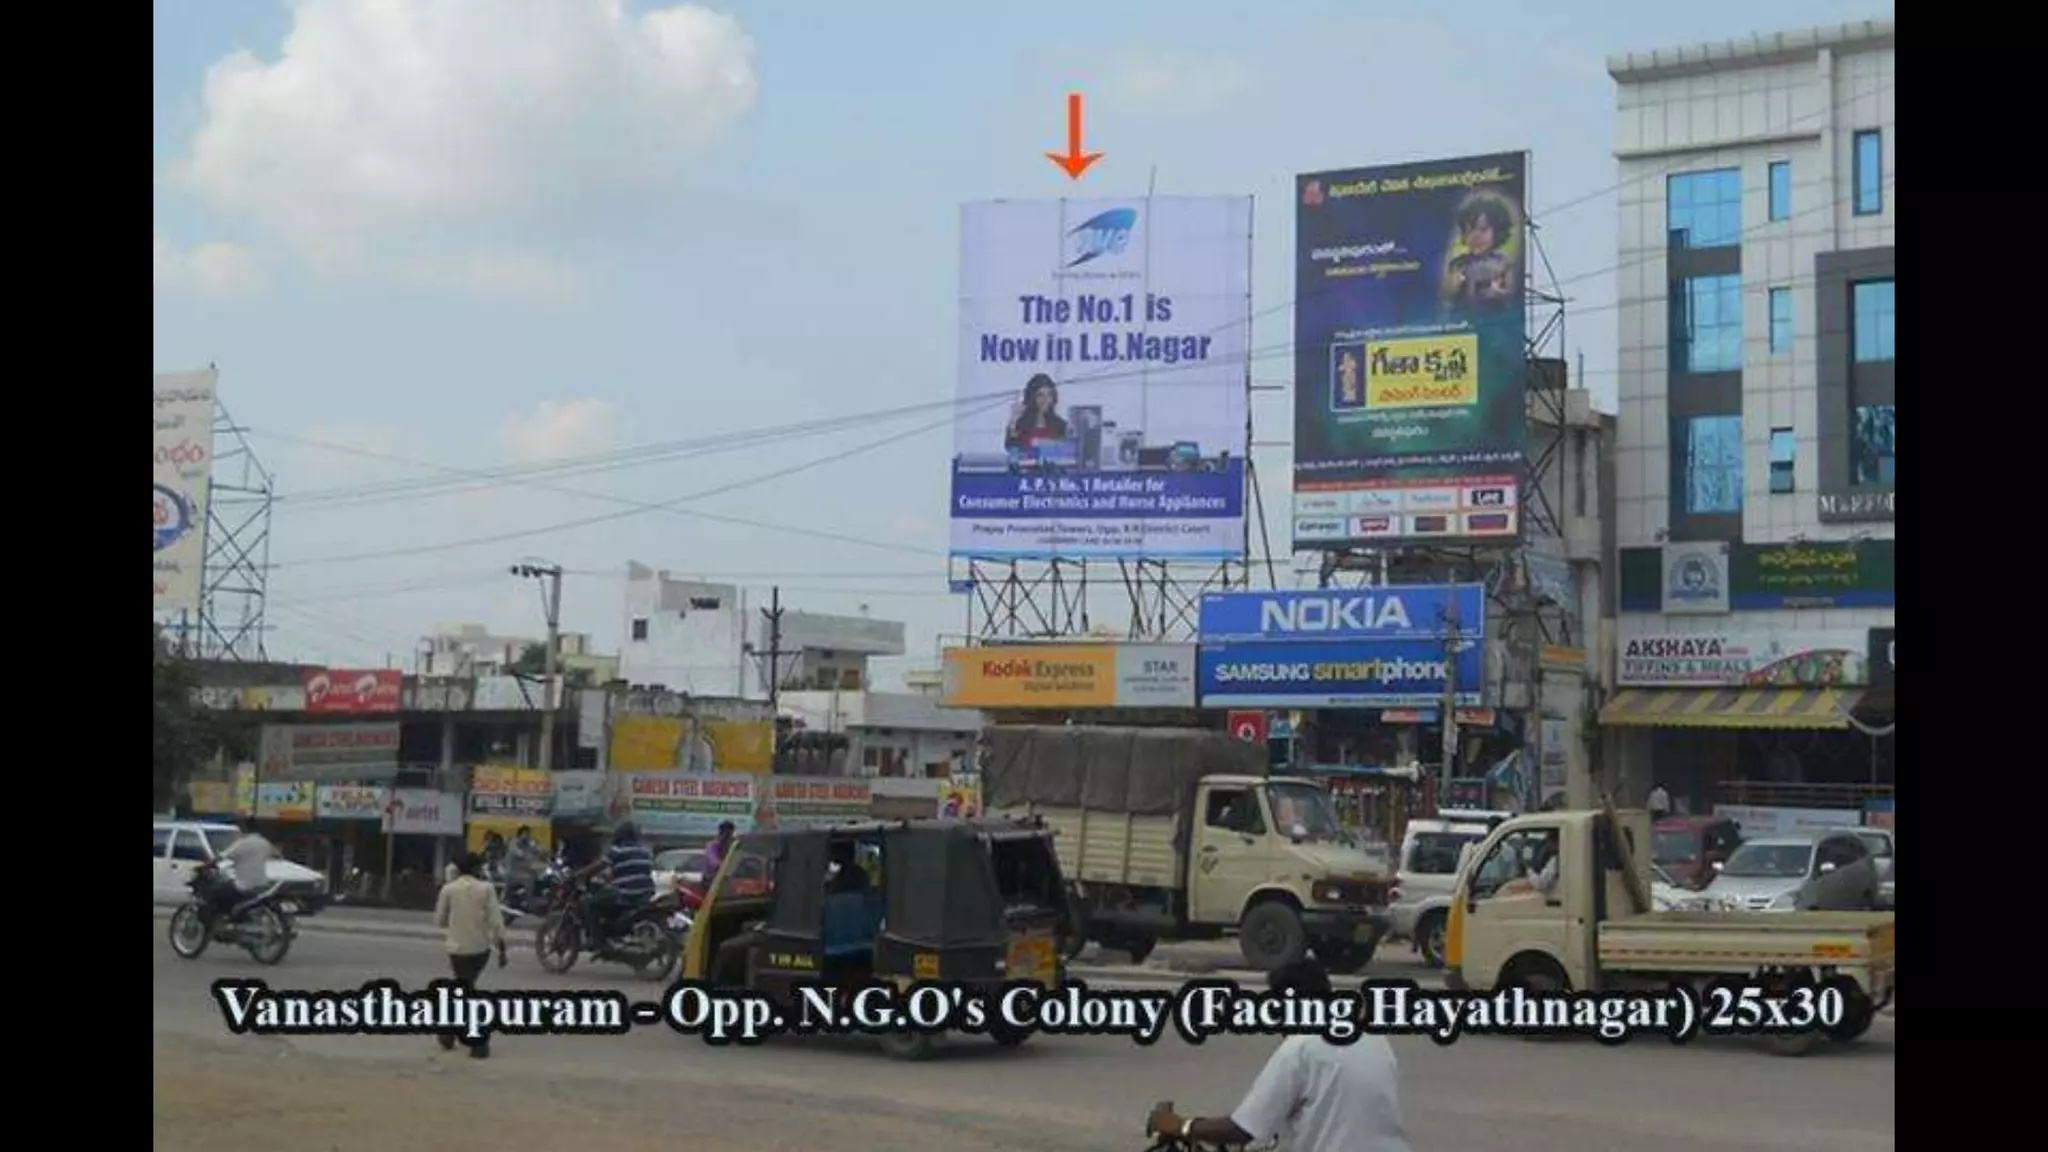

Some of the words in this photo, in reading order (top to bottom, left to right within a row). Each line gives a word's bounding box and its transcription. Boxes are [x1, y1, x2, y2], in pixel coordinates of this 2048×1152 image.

[1019, 295, 1071, 323] The
[1077, 294, 1133, 323] No.1
[1145, 293, 1172, 321] is
[980, 333, 1040, 361] Now
[1045, 333, 1073, 361] in
[1080, 331, 1212, 364] L.B.Nagar
[1092, 478, 1143, 493] Retailer
[959, 494, 1020, 509] Consumer
[1023, 494, 1089, 509] Electronics
[1092, 495, 1116, 508] and
[1260, 596, 1412, 631] NOKIA
[1626, 637, 1723, 657] AKSHAYA
[983, 661, 1031, 677] Kodak
[1034, 662, 1094, 680] Express
[1144, 660, 1179, 674] STAR
[1214, 664, 1310, 681] SAMSUNG
